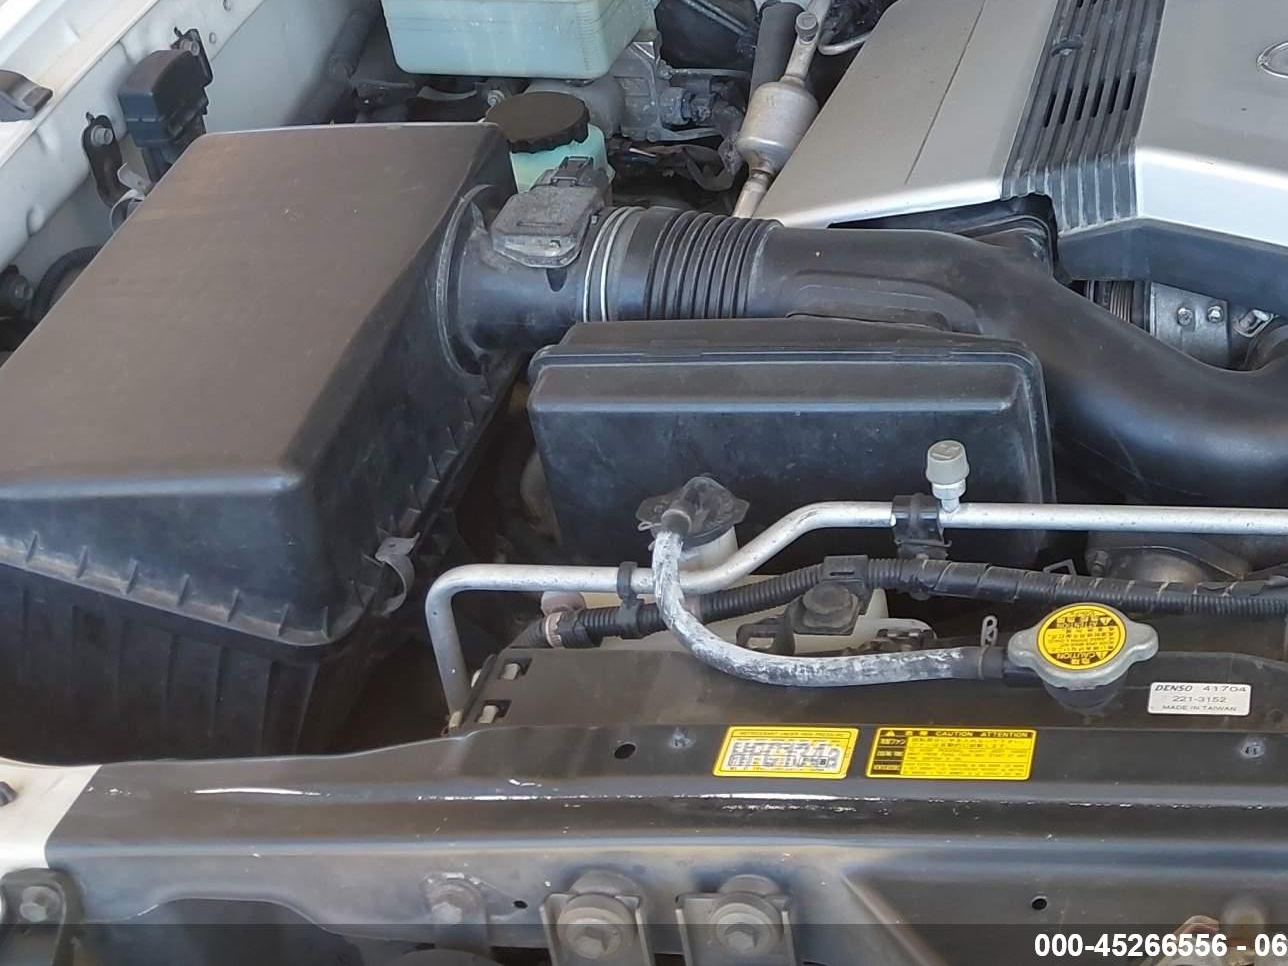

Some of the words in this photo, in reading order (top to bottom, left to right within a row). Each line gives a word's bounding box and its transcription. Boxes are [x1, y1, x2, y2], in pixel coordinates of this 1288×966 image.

[1056, 651, 1097, 660] CAUTION
[1154, 684, 1193, 692] DENSO
[1172, 695, 1227, 703] 221-3152
